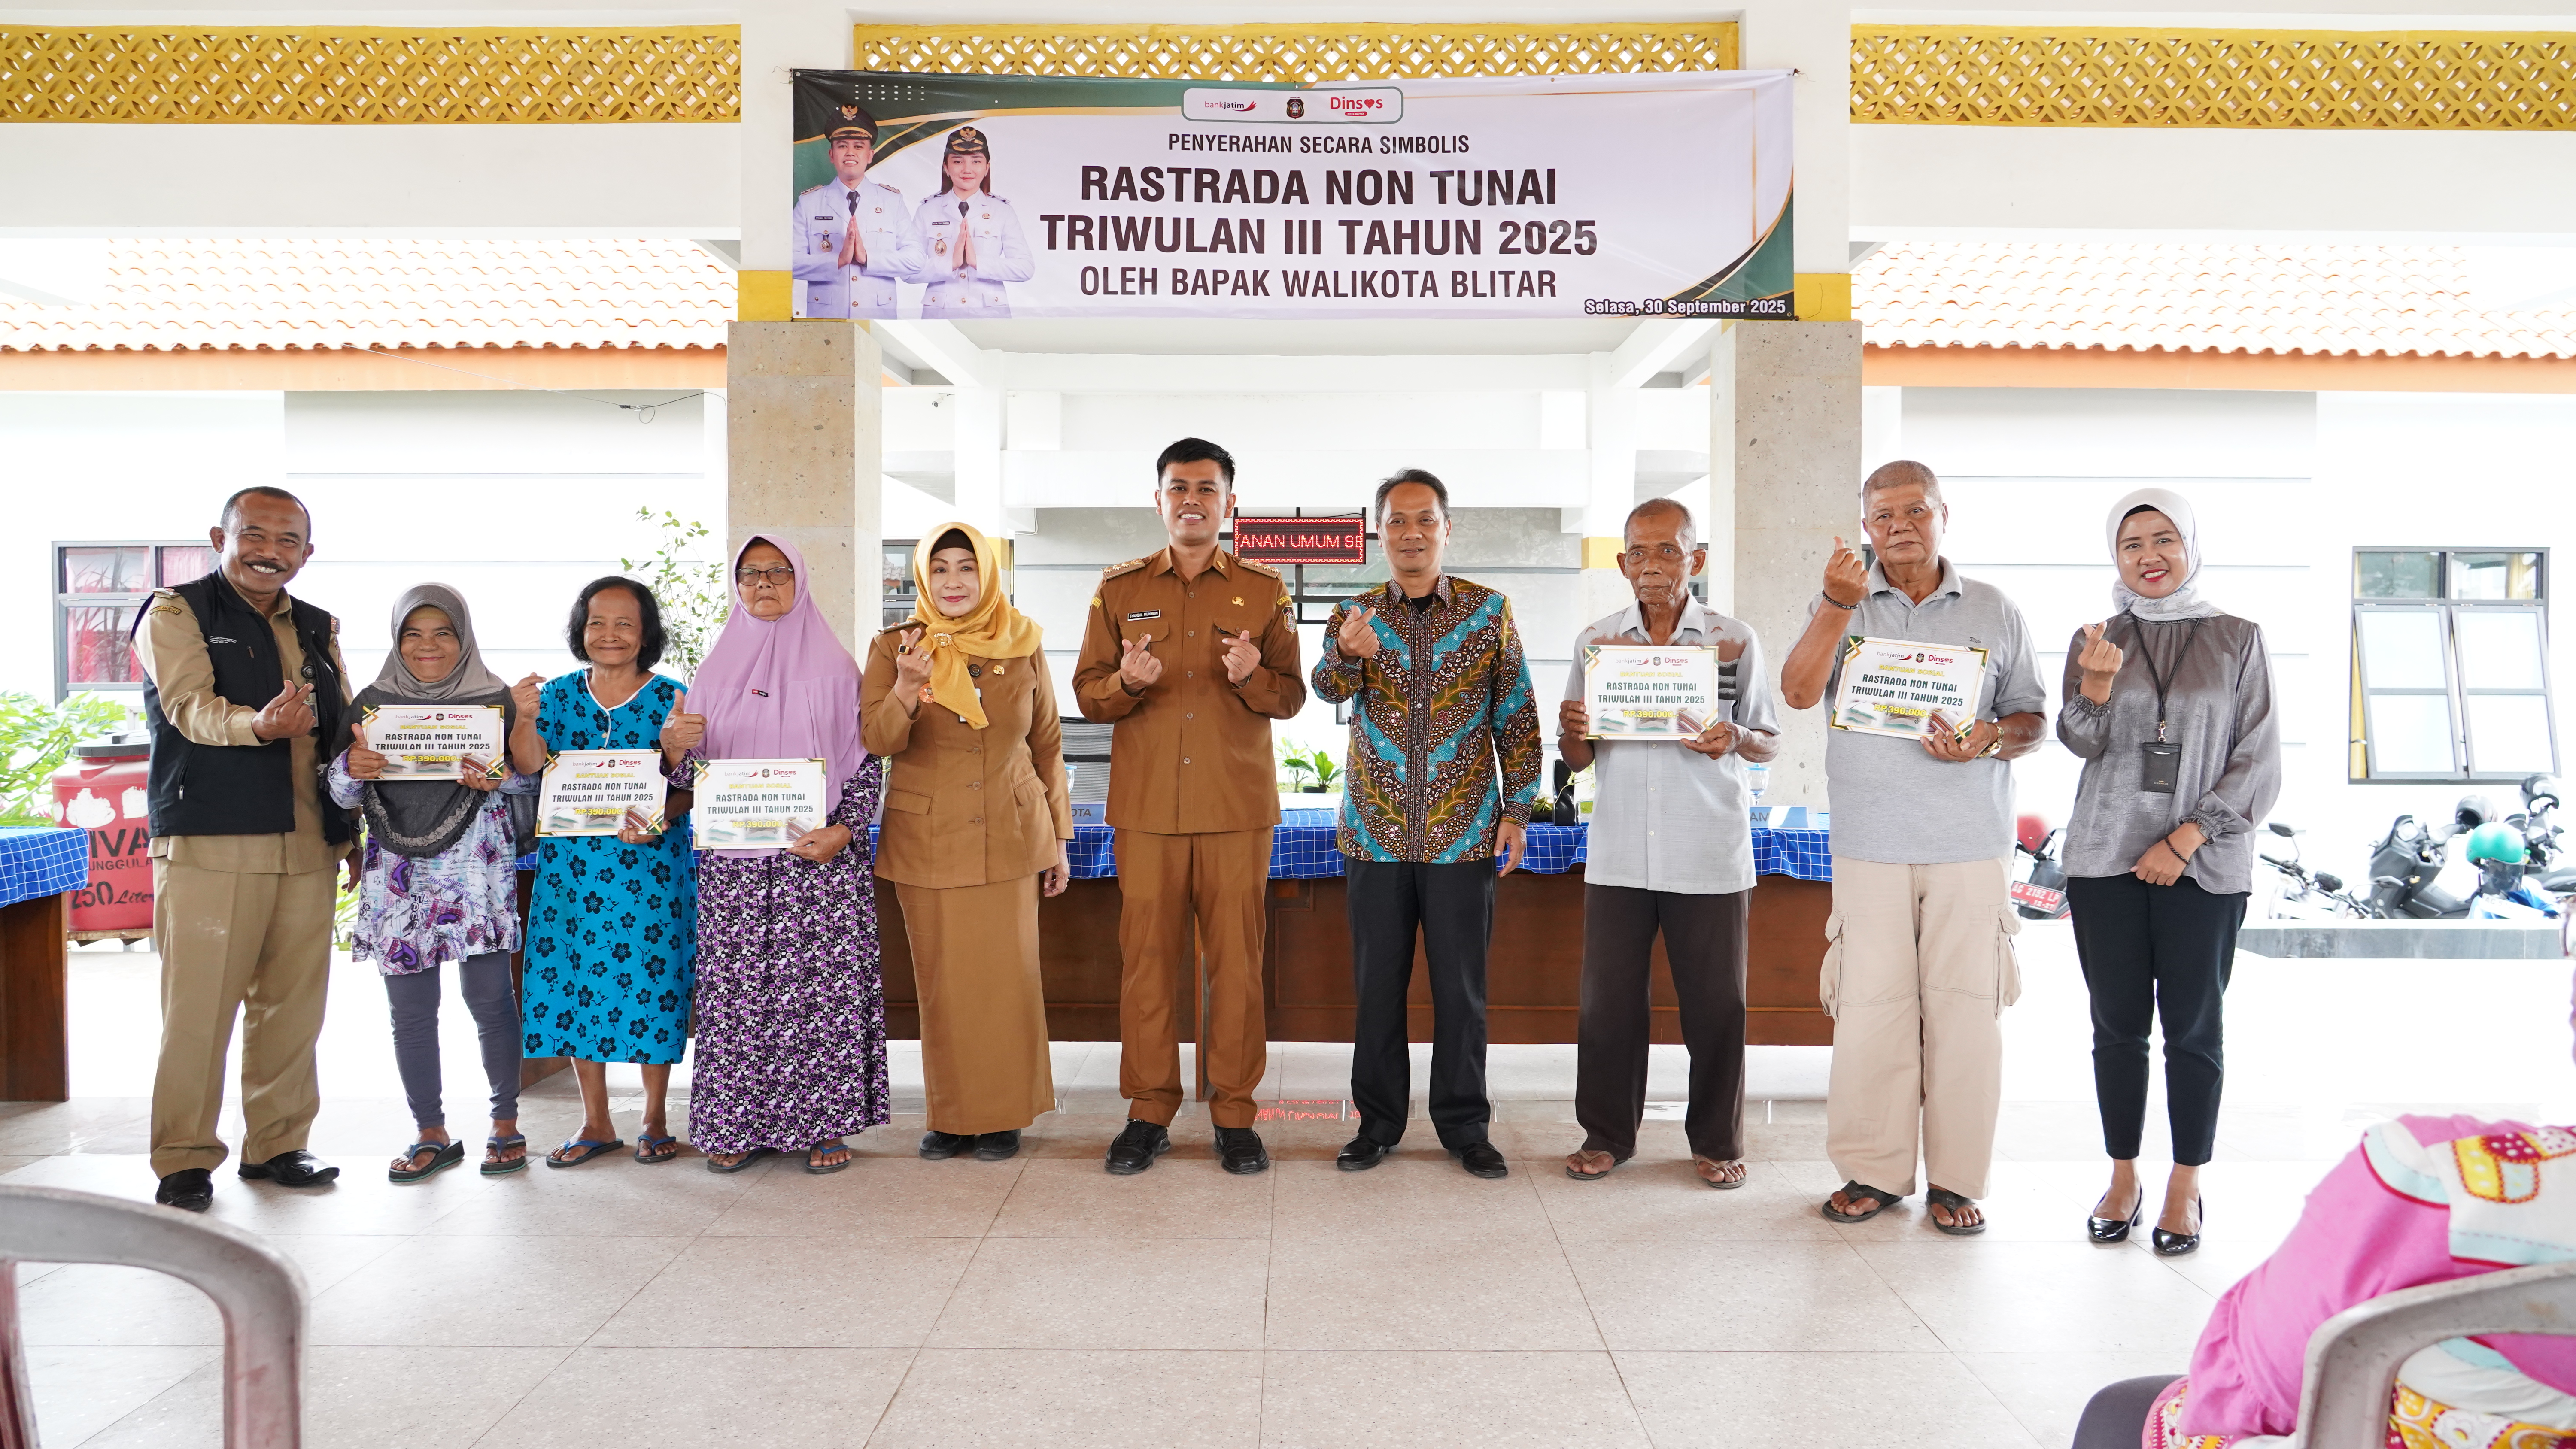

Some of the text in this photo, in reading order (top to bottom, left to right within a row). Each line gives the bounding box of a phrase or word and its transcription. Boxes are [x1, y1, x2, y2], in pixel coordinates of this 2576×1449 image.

[1205, 101, 1244, 110] bankjatim
[1169, 134, 1469, 154] PENYERAHAN SECARA SIMBOLIS
[1082, 166, 1555, 206] RASTRADA NON TUNAI
[1040, 215, 1597, 256] TRIWULAN III TAHUN 2025
[1081, 266, 1556, 298] OLEH BAPAK WALIKOTA BLITAR
[1586, 300, 1786, 315] Selasa, 30 September 2025
[1238, 535, 1285, 548] ANAN
[1290, 535, 1339, 548] UMUM
[1879, 665, 1915, 673] BANTUAN
[1862, 674, 1957, 692] RASTRADA NON TUNAI
[1852, 685, 1963, 706] TRIWULAN III TAHUN 2025
[2026, 888, 2047, 899] 2152
[2047, 893, 2060, 902] LP
